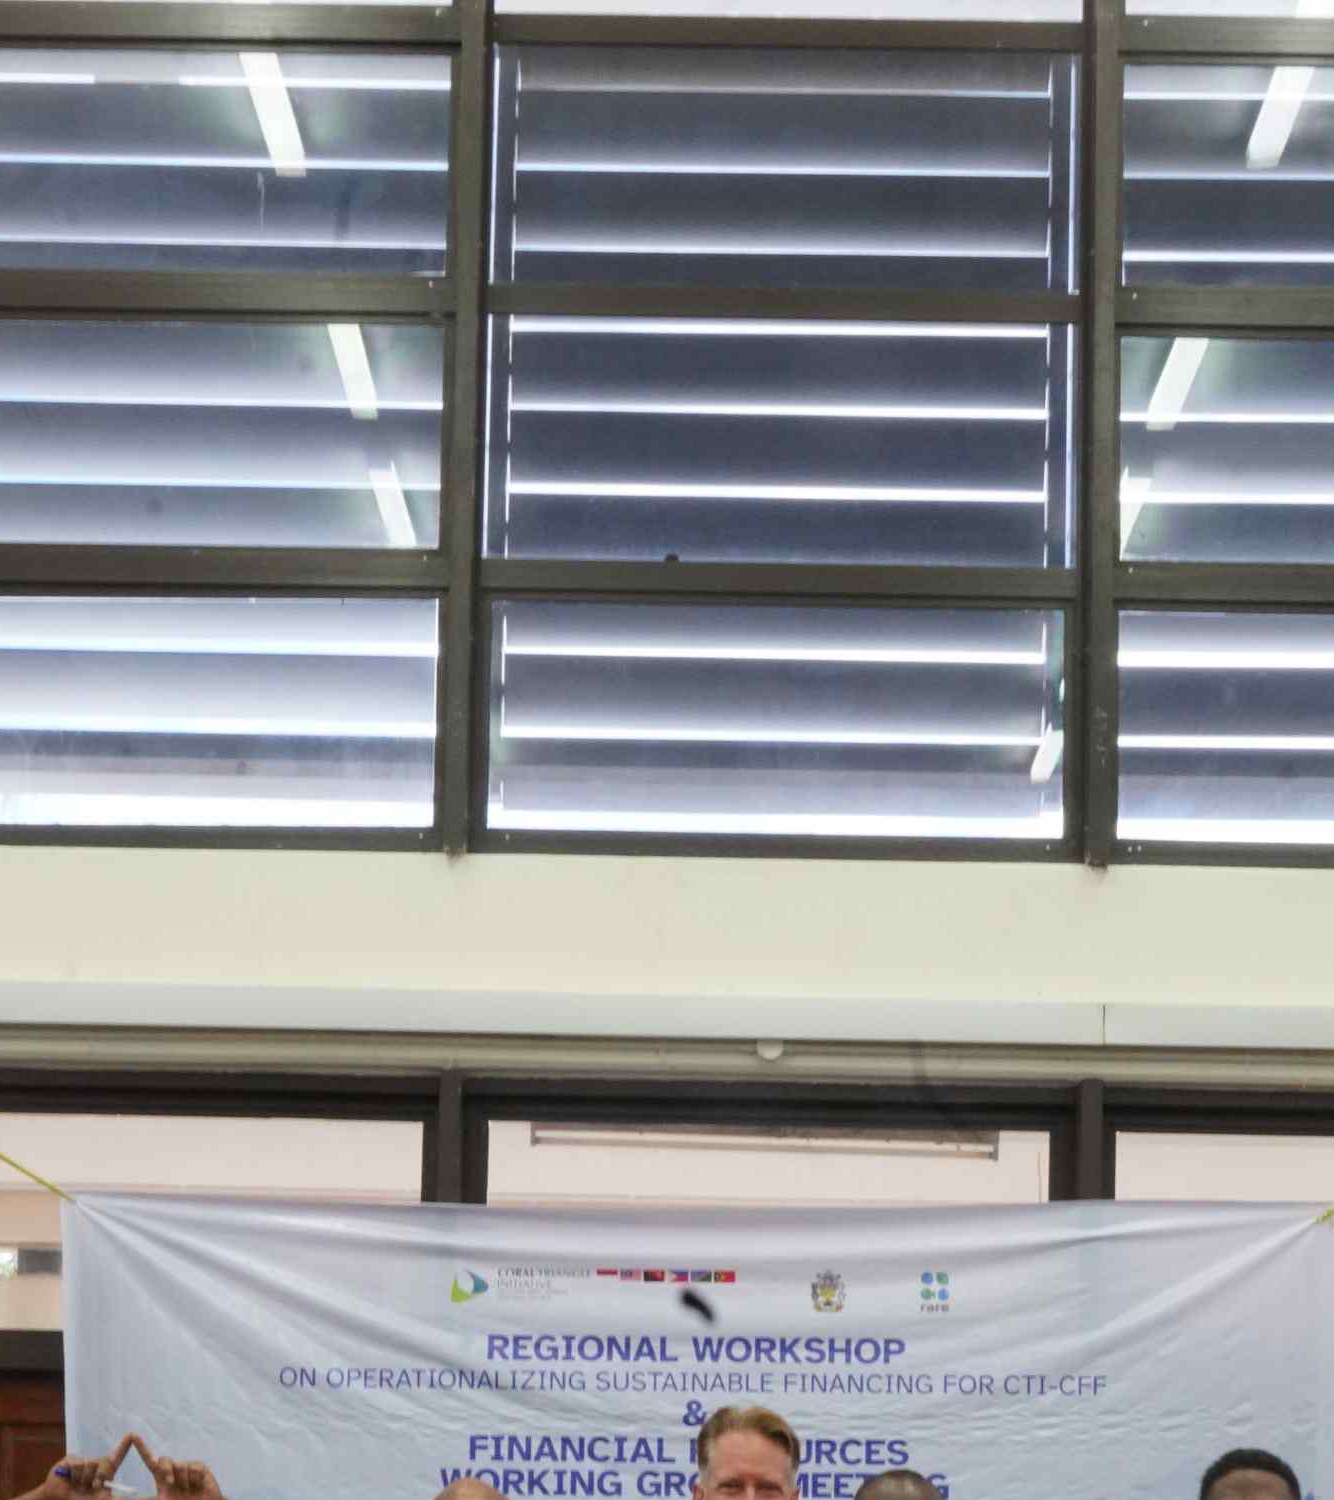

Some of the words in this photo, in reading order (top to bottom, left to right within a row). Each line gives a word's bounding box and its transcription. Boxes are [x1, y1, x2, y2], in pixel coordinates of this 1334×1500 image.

[486, 1333, 679, 1362] REGIONAL
[691, 1335, 907, 1364] WORKSHOP
[279, 1366, 317, 1389] ON
[326, 1367, 587, 1393] OPERATIONALIZING
[595, 1370, 774, 1394] SUSTAINABLE
[783, 1372, 934, 1395] FINANCING
[942, 1373, 996, 1396] FOR
[1002, 1373, 1108, 1397] CTI-CFF
[682, 1400, 708, 1427] &
[468, 1433, 677, 1464] FINANCIAL
